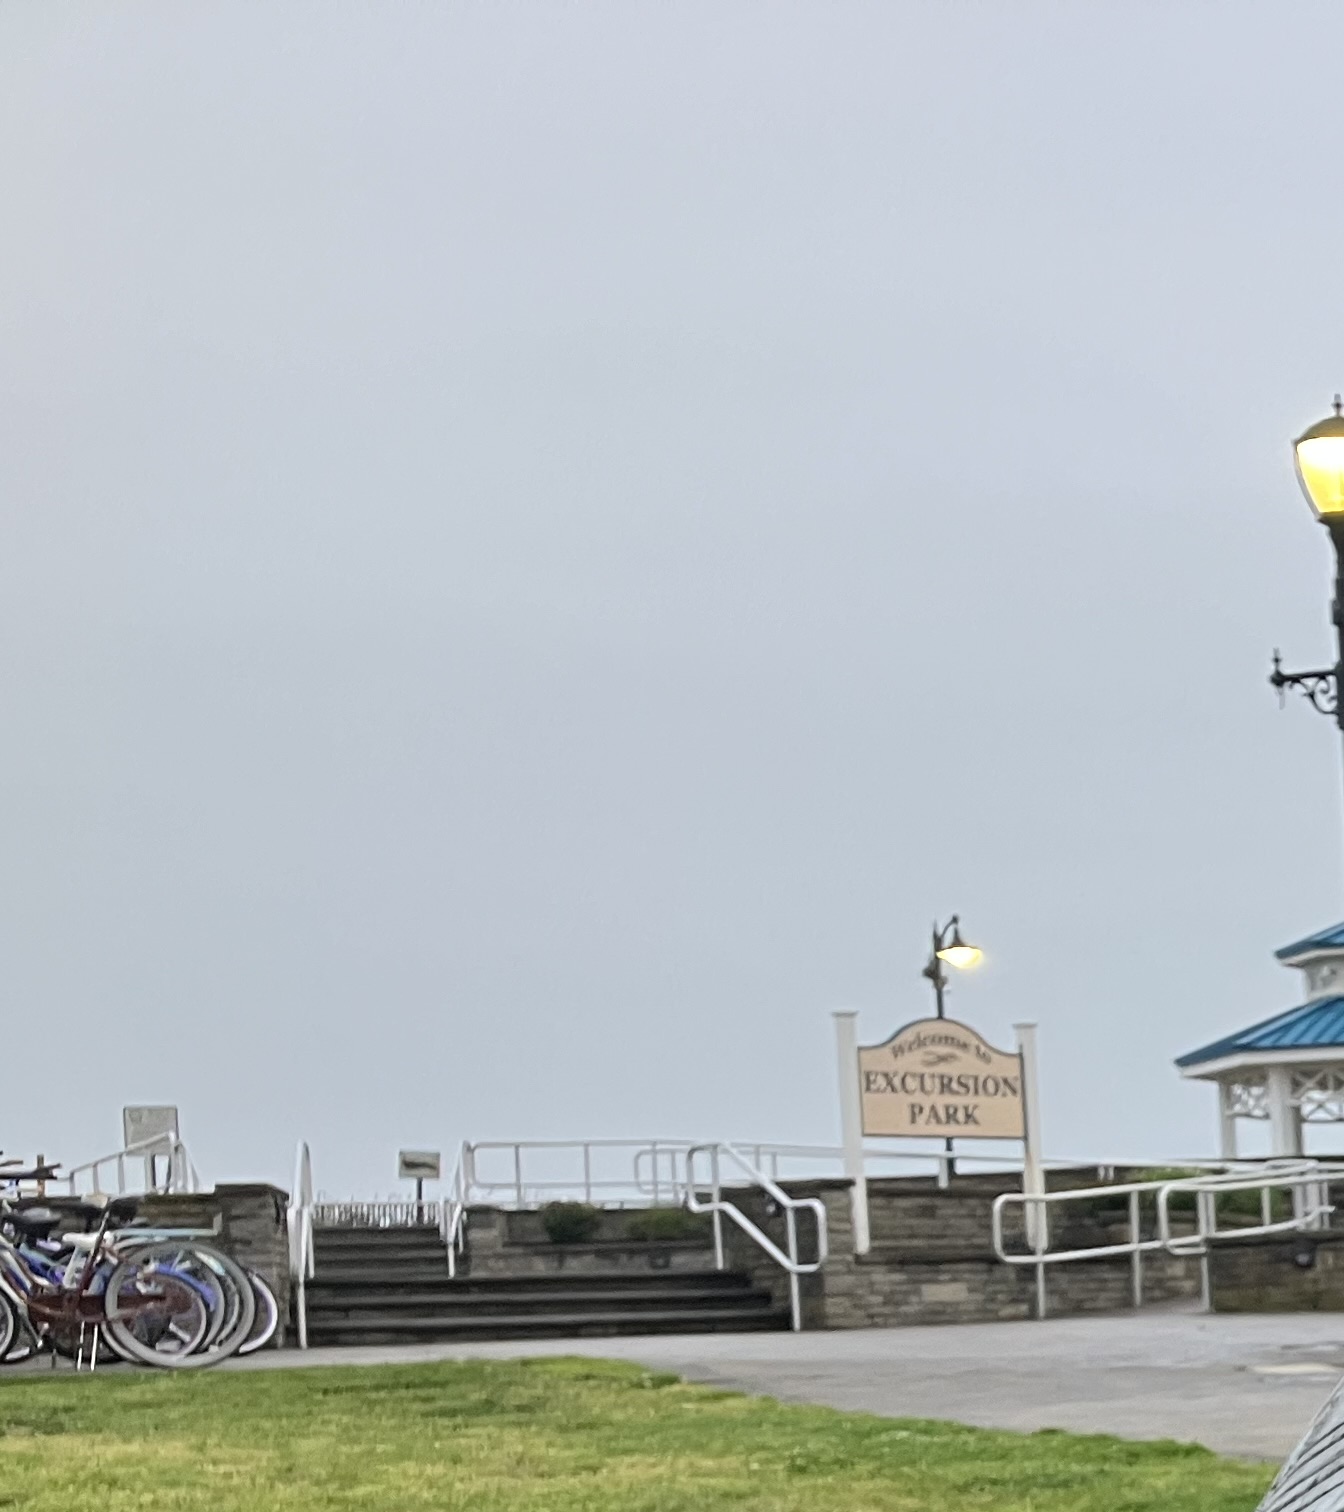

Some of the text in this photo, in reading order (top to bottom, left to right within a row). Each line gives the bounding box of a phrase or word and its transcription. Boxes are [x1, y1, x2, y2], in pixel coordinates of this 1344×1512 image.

[889, 1031, 969, 1060] Welcome
[863, 1070, 1020, 1098] EXCURSION
[907, 1102, 981, 1126] PARK
